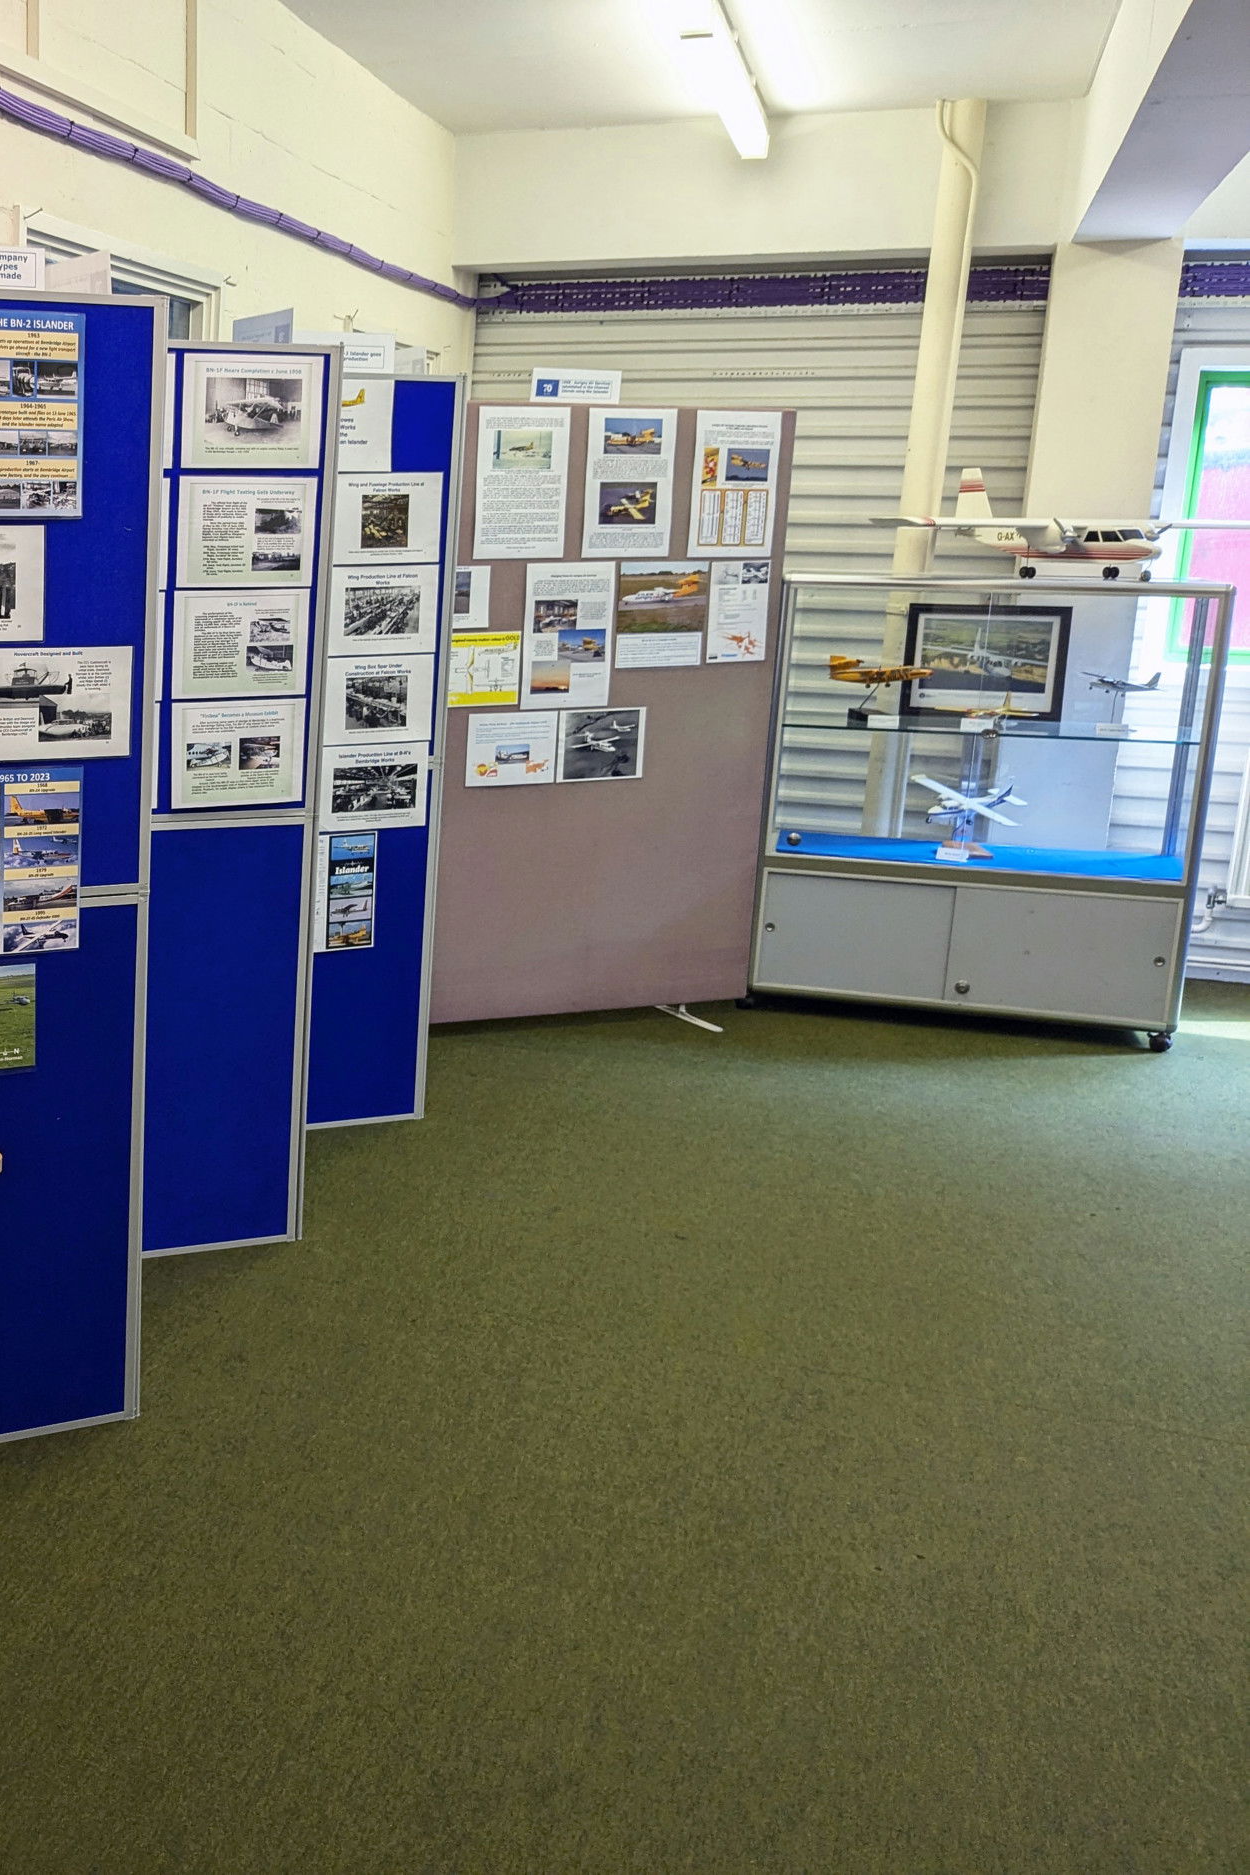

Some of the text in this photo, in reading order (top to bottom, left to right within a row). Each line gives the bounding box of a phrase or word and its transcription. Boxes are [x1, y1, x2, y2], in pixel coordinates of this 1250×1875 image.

[10, 319, 31, 328] BN-2
[33, 320, 74, 330] ISLANDER
[543, 383, 553, 393] 70
[17, 773, 28, 782] TO
[30, 773, 50, 781] 2023
[335, 865, 370, 875] Islander
